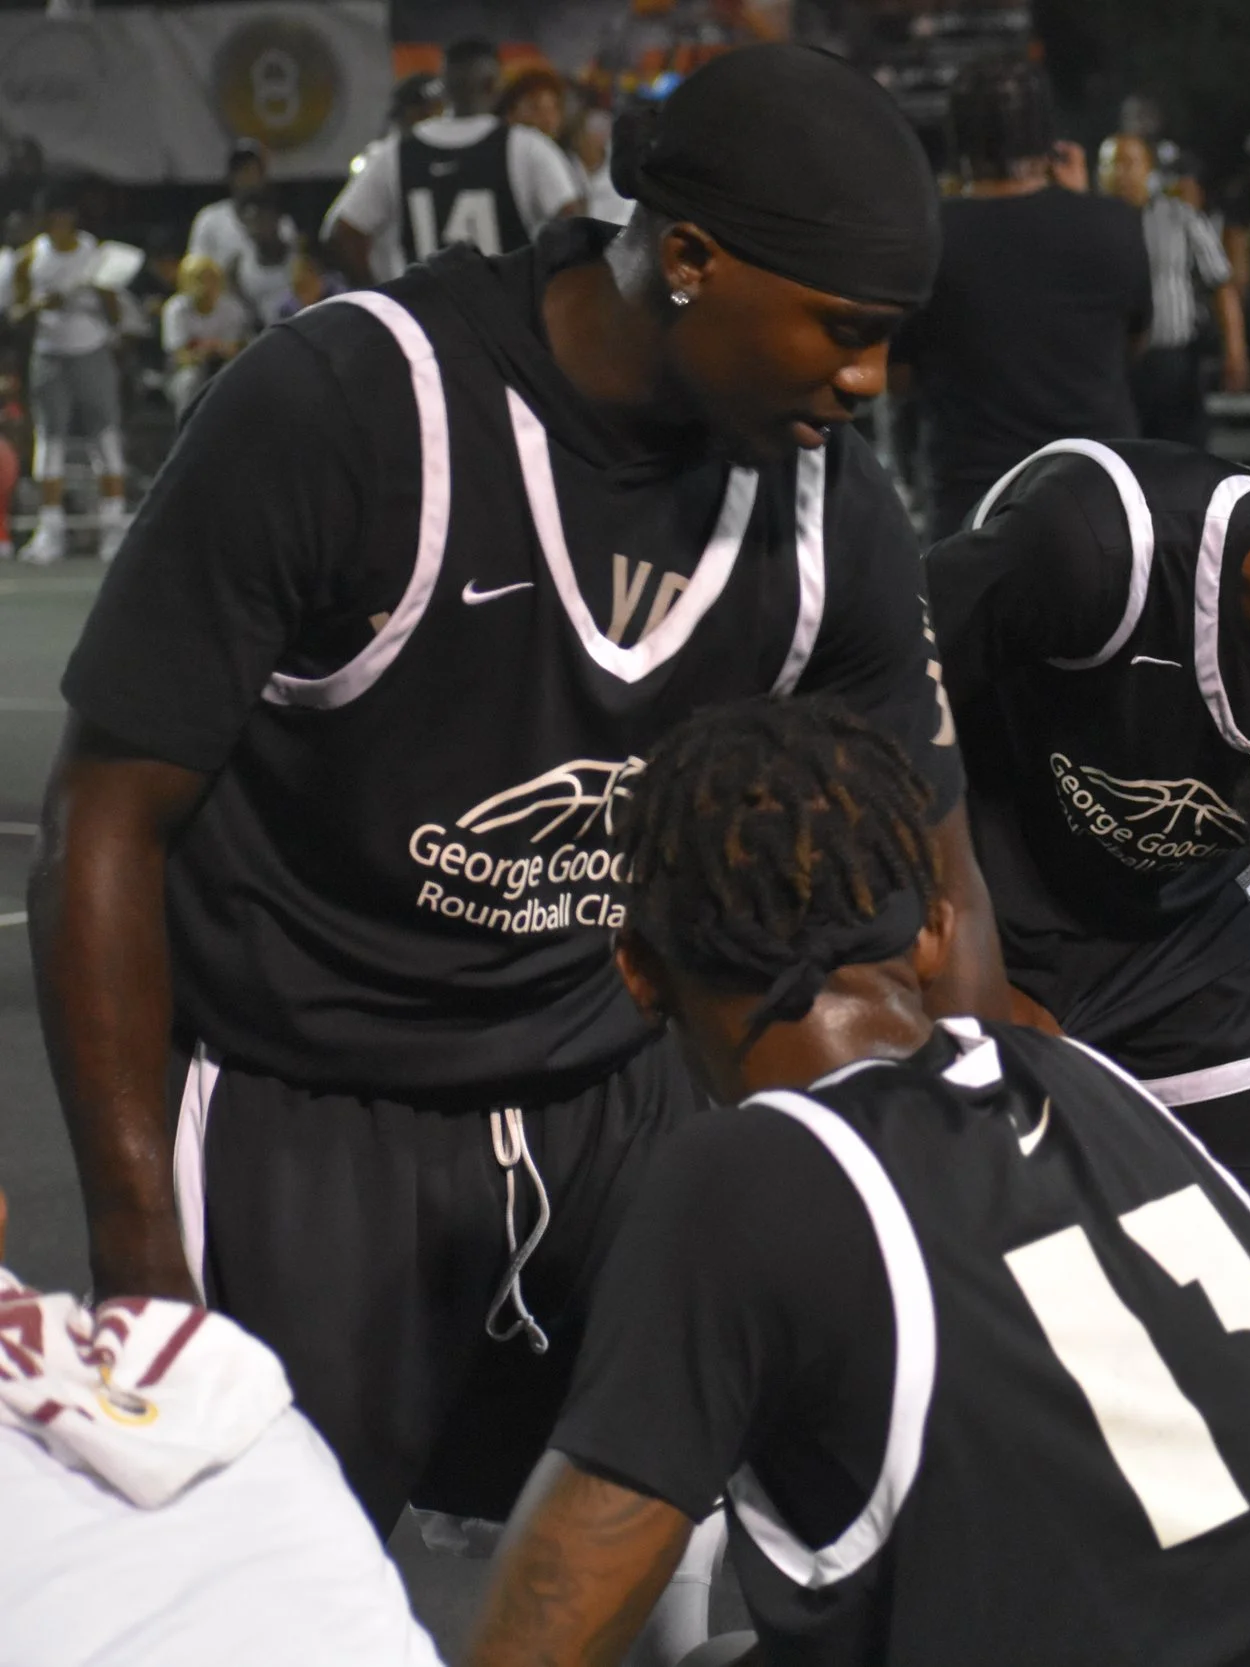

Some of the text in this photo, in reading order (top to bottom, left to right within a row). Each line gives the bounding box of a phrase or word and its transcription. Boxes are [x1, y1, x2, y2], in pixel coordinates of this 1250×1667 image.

[407, 187, 501, 260] 14
[1050, 752, 1134, 843] George
[408, 823, 543, 900] George
[415, 880, 572, 935] Roundball
